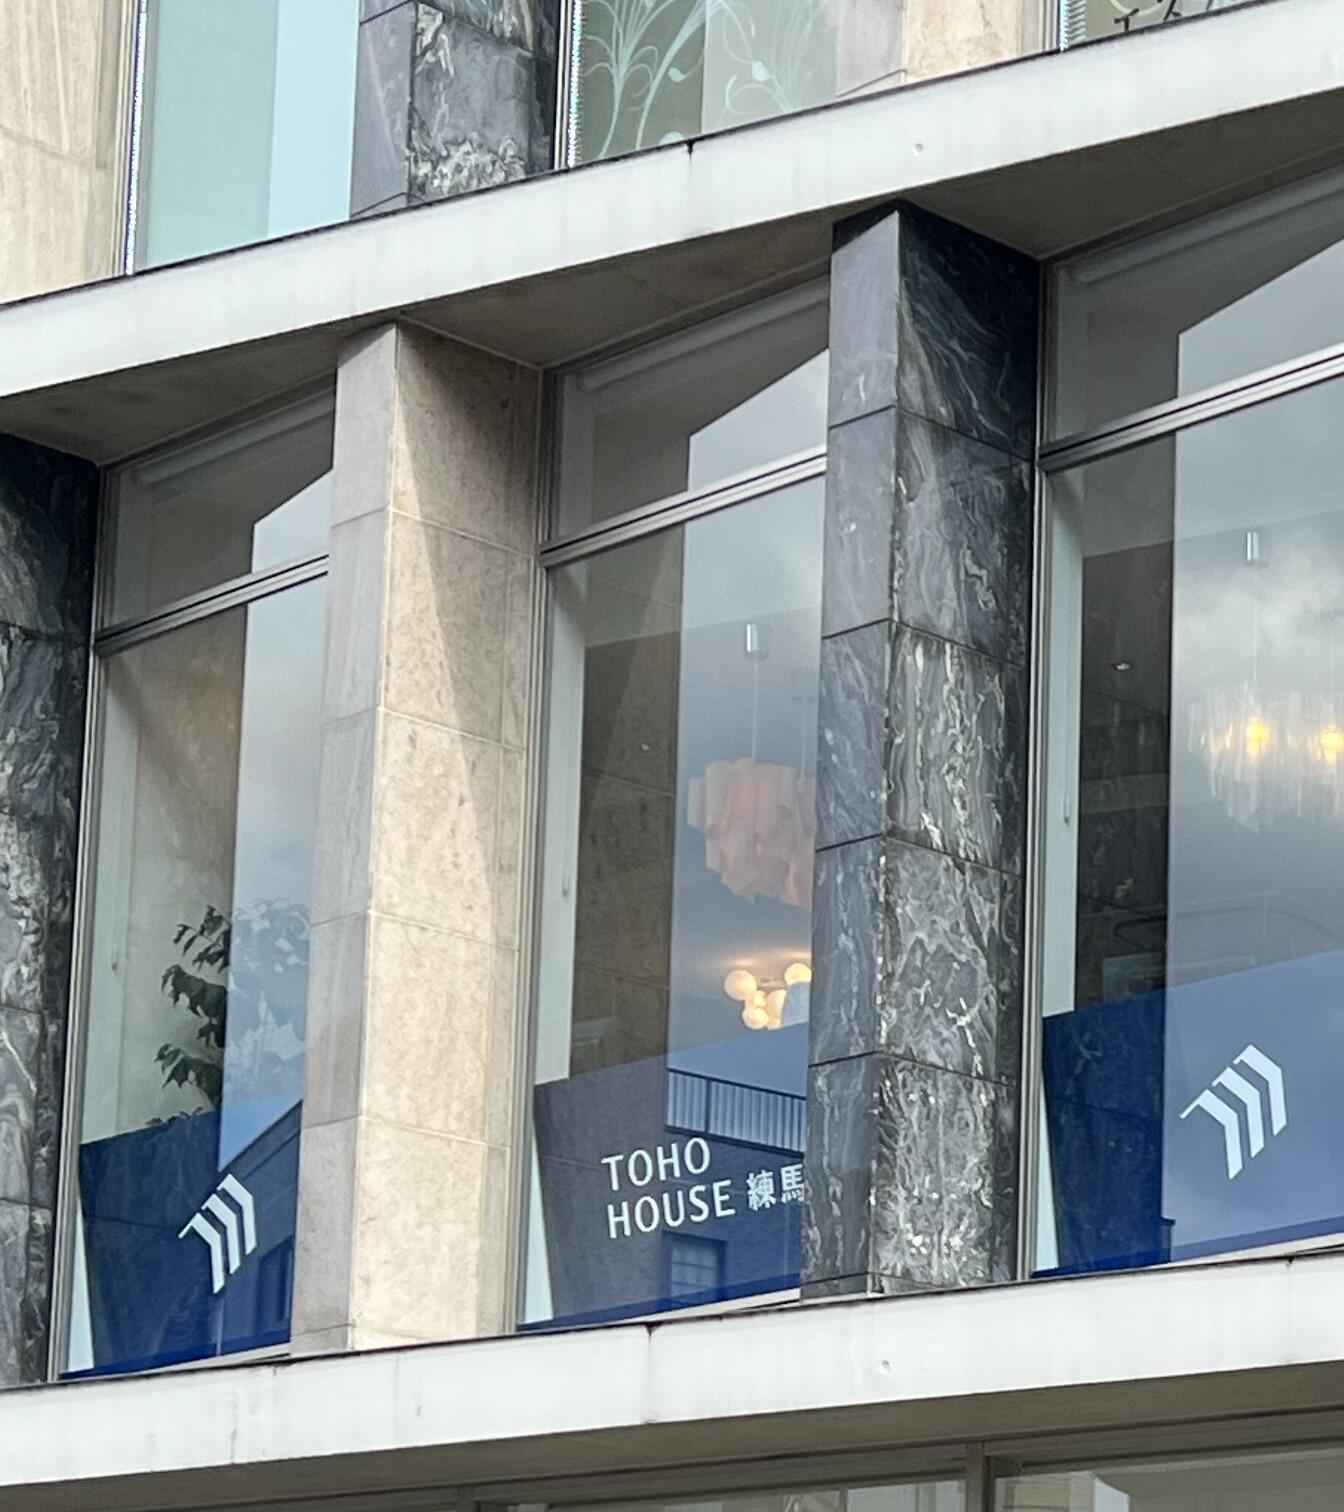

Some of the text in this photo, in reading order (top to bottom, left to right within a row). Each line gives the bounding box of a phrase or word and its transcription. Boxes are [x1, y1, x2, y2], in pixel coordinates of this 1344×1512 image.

[602, 1136, 711, 1193] TOHO
[606, 1163, 804, 1240] HOUSE 練馬
